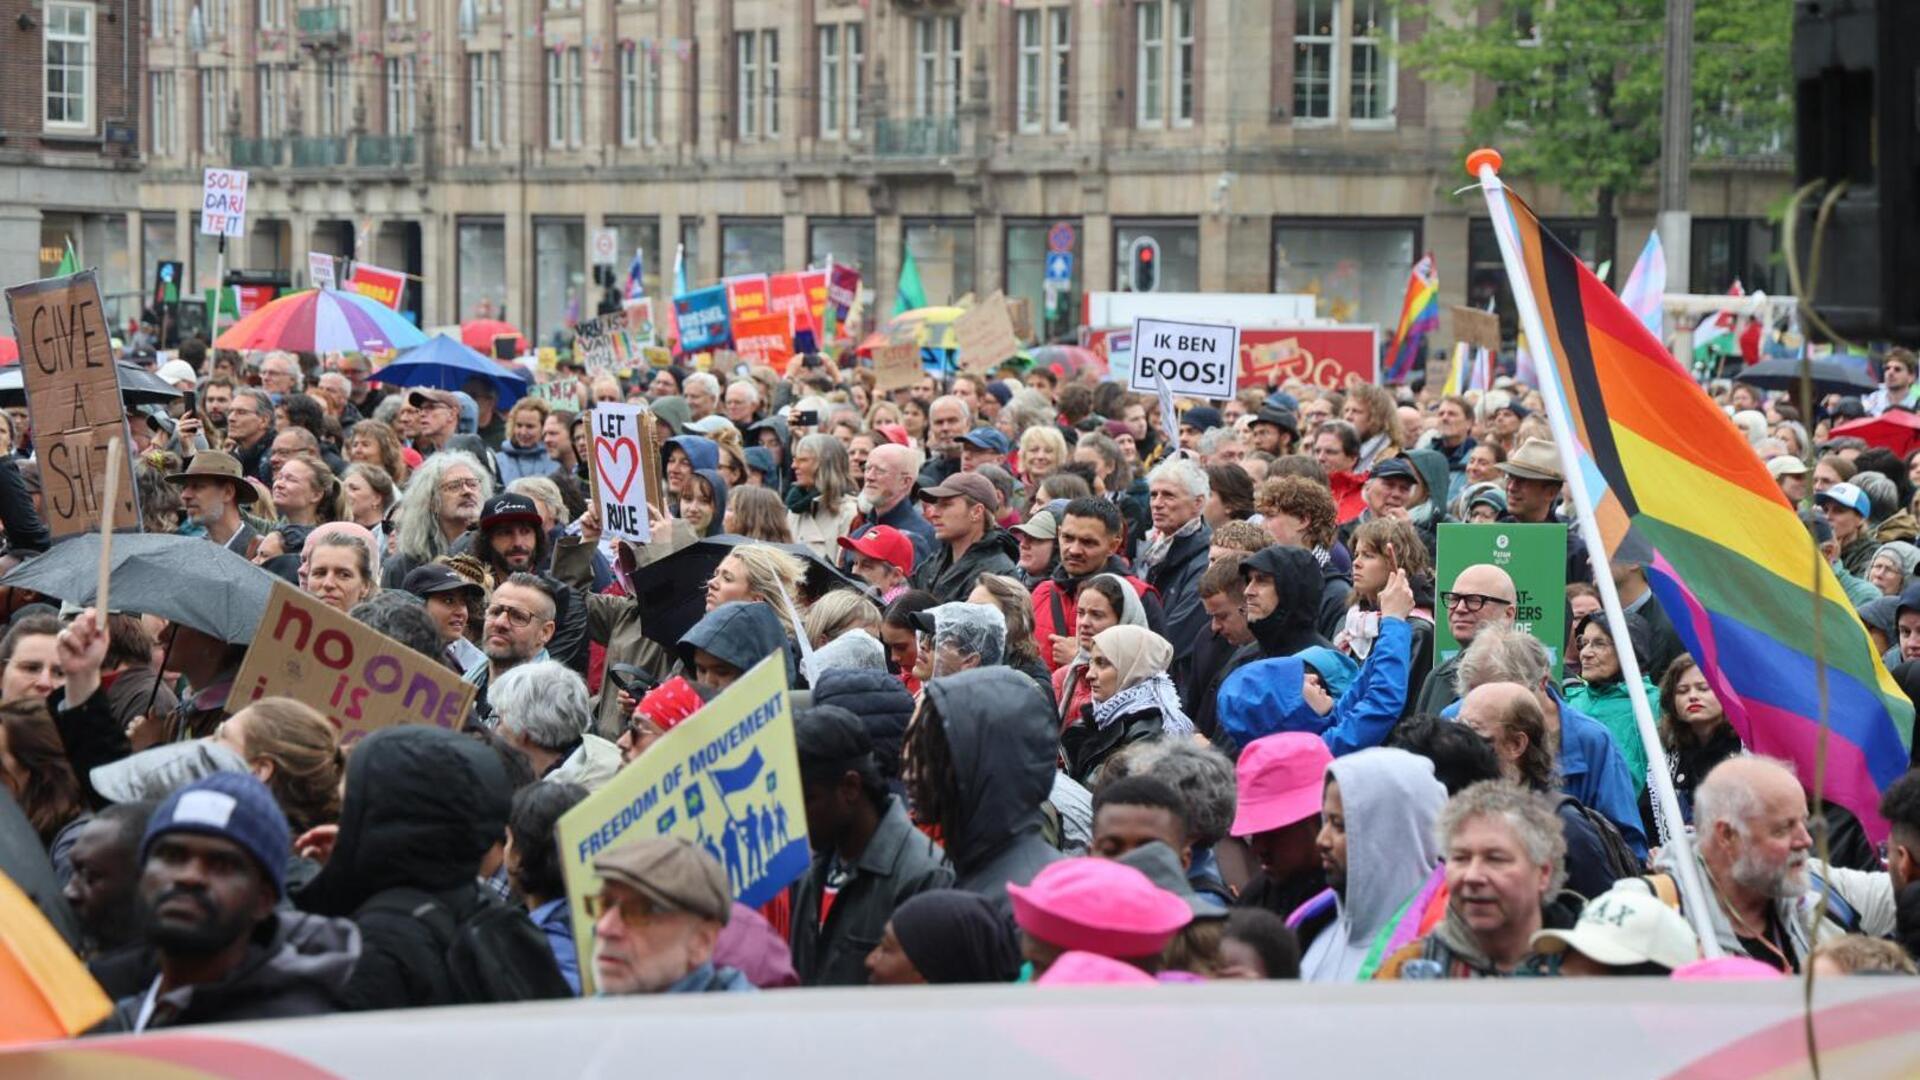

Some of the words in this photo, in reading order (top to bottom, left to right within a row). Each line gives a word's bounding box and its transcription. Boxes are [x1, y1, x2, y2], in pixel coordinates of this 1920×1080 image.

[207, 172, 246, 192] SOLI
[205, 193, 244, 214] DARI
[207, 213, 241, 233] TEIT
[32, 301, 103, 375] GIVE
[1154, 333, 1172, 349] IK
[1178, 335, 1216, 353] BEN
[1141, 357, 1225, 385] BOOS!
[72, 383, 90, 428] A
[600, 413, 625, 438] LET
[48, 442, 112, 519] SHI
[606, 503, 639, 535] RULE
[273, 601, 354, 670] no
[578, 785, 658, 863] FREEDOM
[662, 764, 682, 794] OF
[689, 691, 783, 777] MOVEMENT
